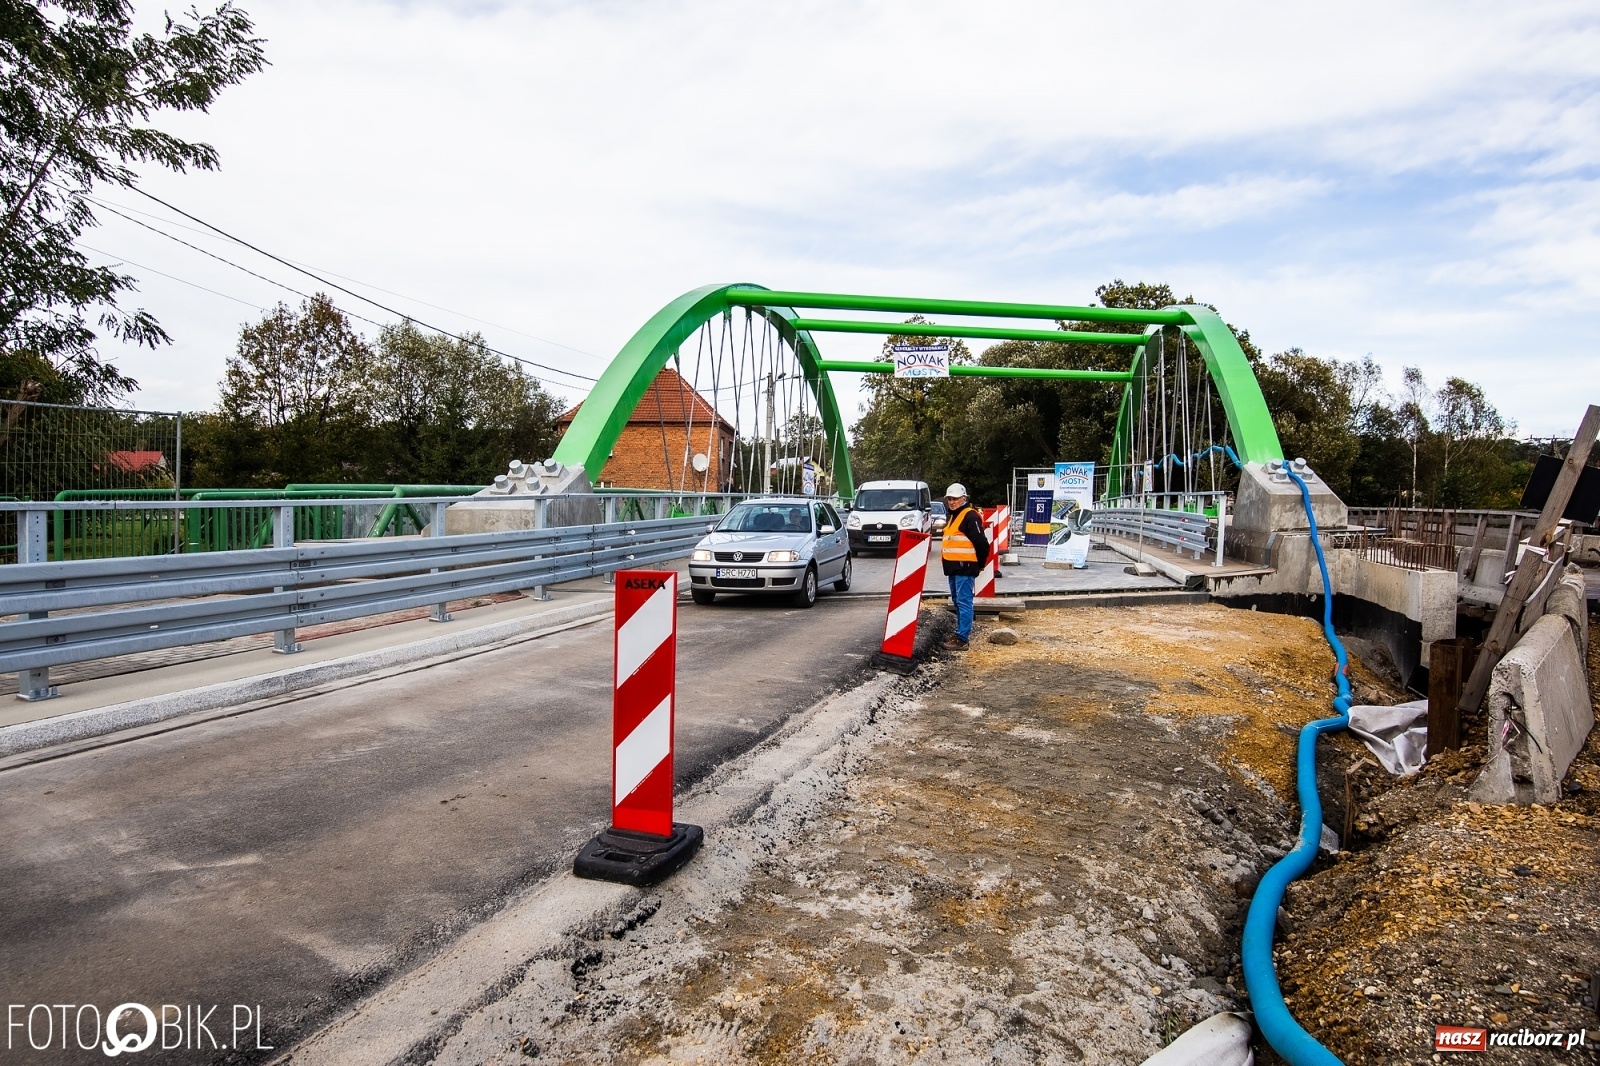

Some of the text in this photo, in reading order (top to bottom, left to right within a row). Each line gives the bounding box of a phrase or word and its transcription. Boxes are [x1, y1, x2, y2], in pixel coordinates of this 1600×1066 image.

[897, 354, 945, 369] NOWAK
[902, 368, 941, 377] MOSTY
[1060, 466, 1088, 478] NOWAK
[720, 568, 756, 577] SRC H770
[625, 578, 666, 590] ASEKA
